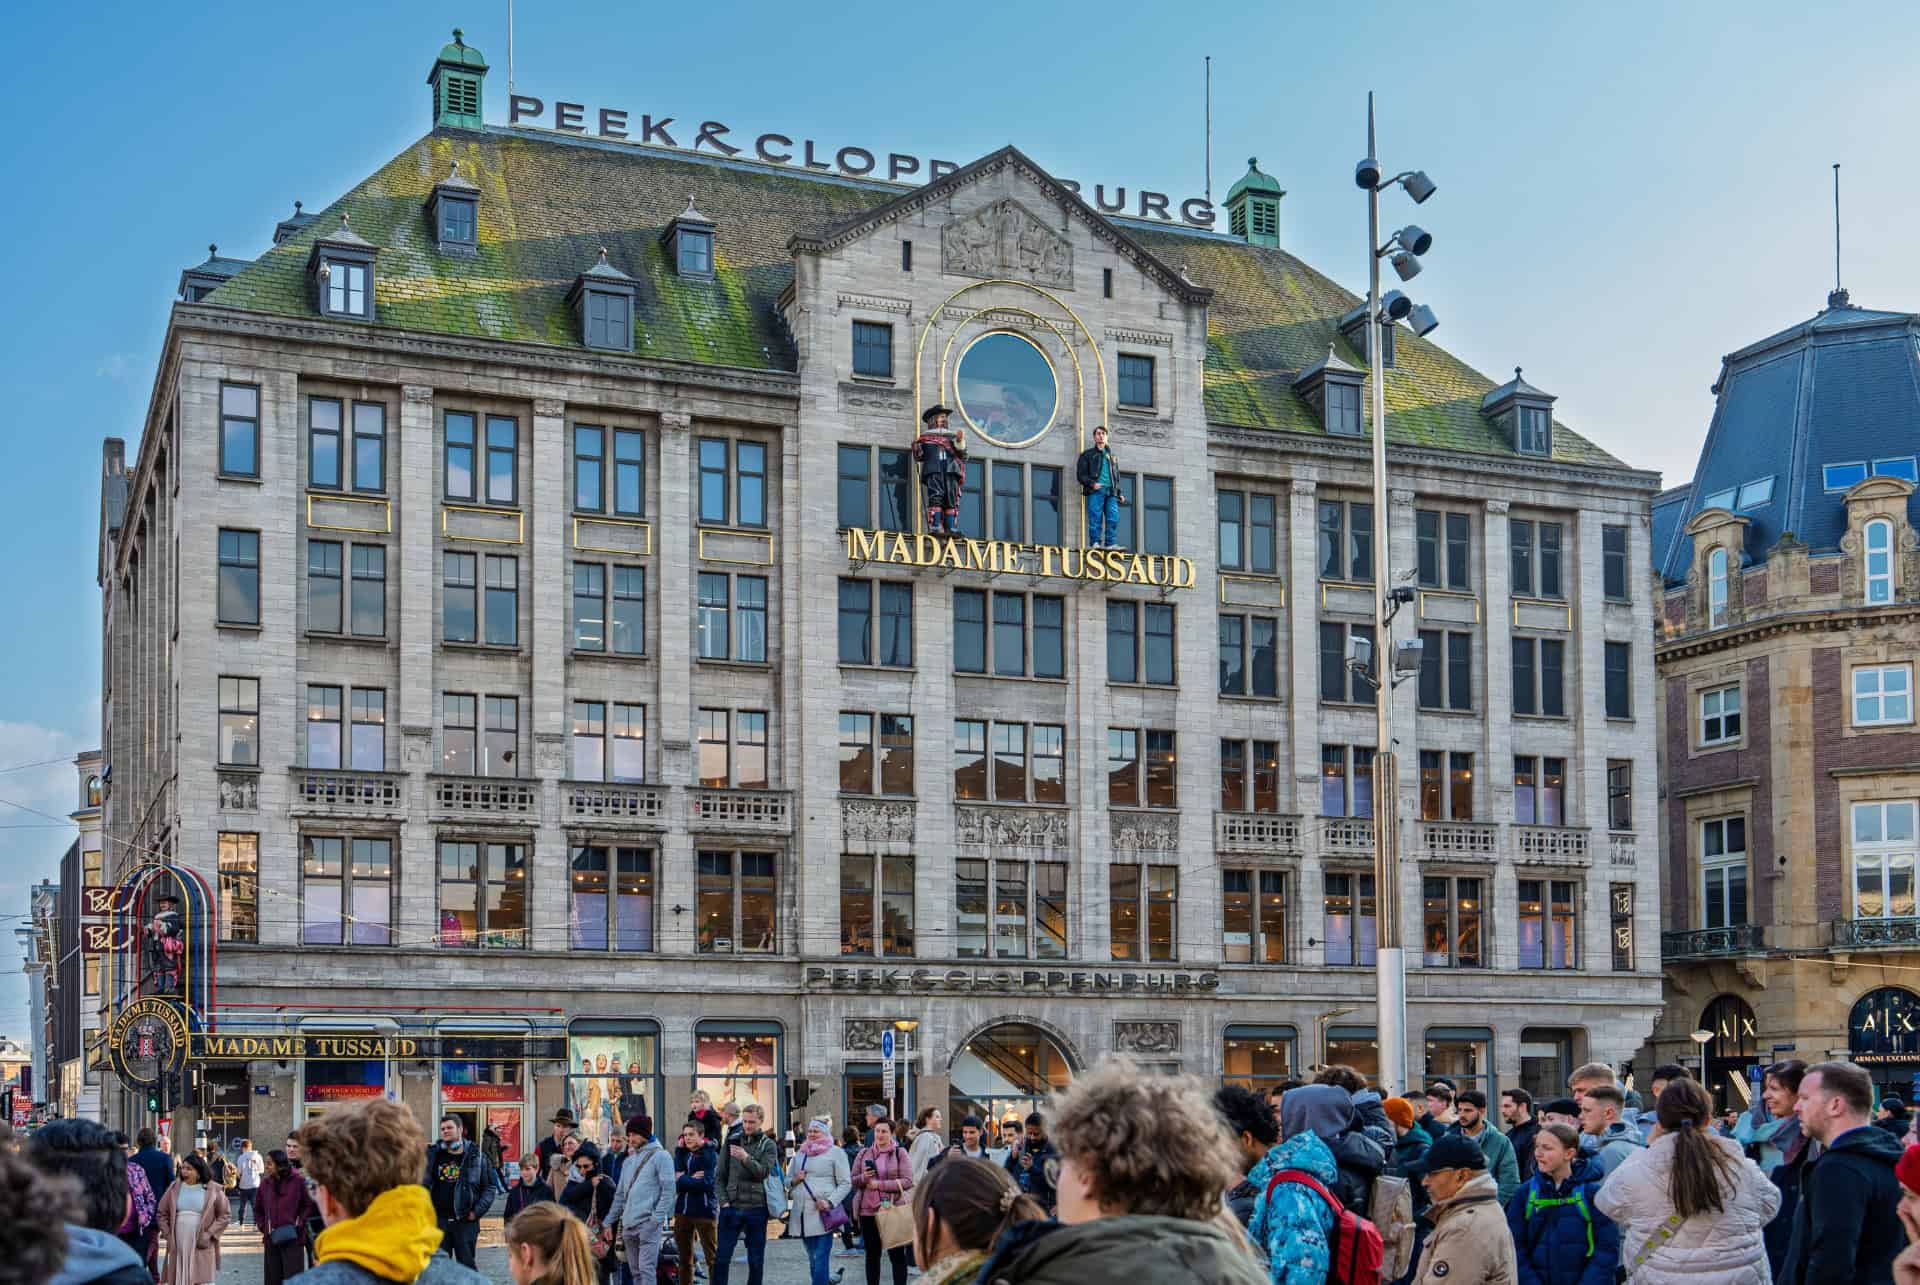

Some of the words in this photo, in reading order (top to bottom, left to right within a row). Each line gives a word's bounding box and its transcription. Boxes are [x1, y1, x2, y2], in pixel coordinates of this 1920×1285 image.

[509, 94, 678, 147] PEEK
[848, 527, 1025, 574] MADAME
[1035, 543, 1196, 588] TUSSAUD
[805, 967, 899, 988] PEEK
[943, 969, 1221, 992] CLOPPENBURG
[111, 1001, 148, 1049] MADAME
[151, 1001, 185, 1047] TUSSAUD
[204, 1037, 307, 1056] MADAME
[315, 1039, 417, 1057] TUSSAUD
[1855, 1055, 1885, 1063] ARMANI
